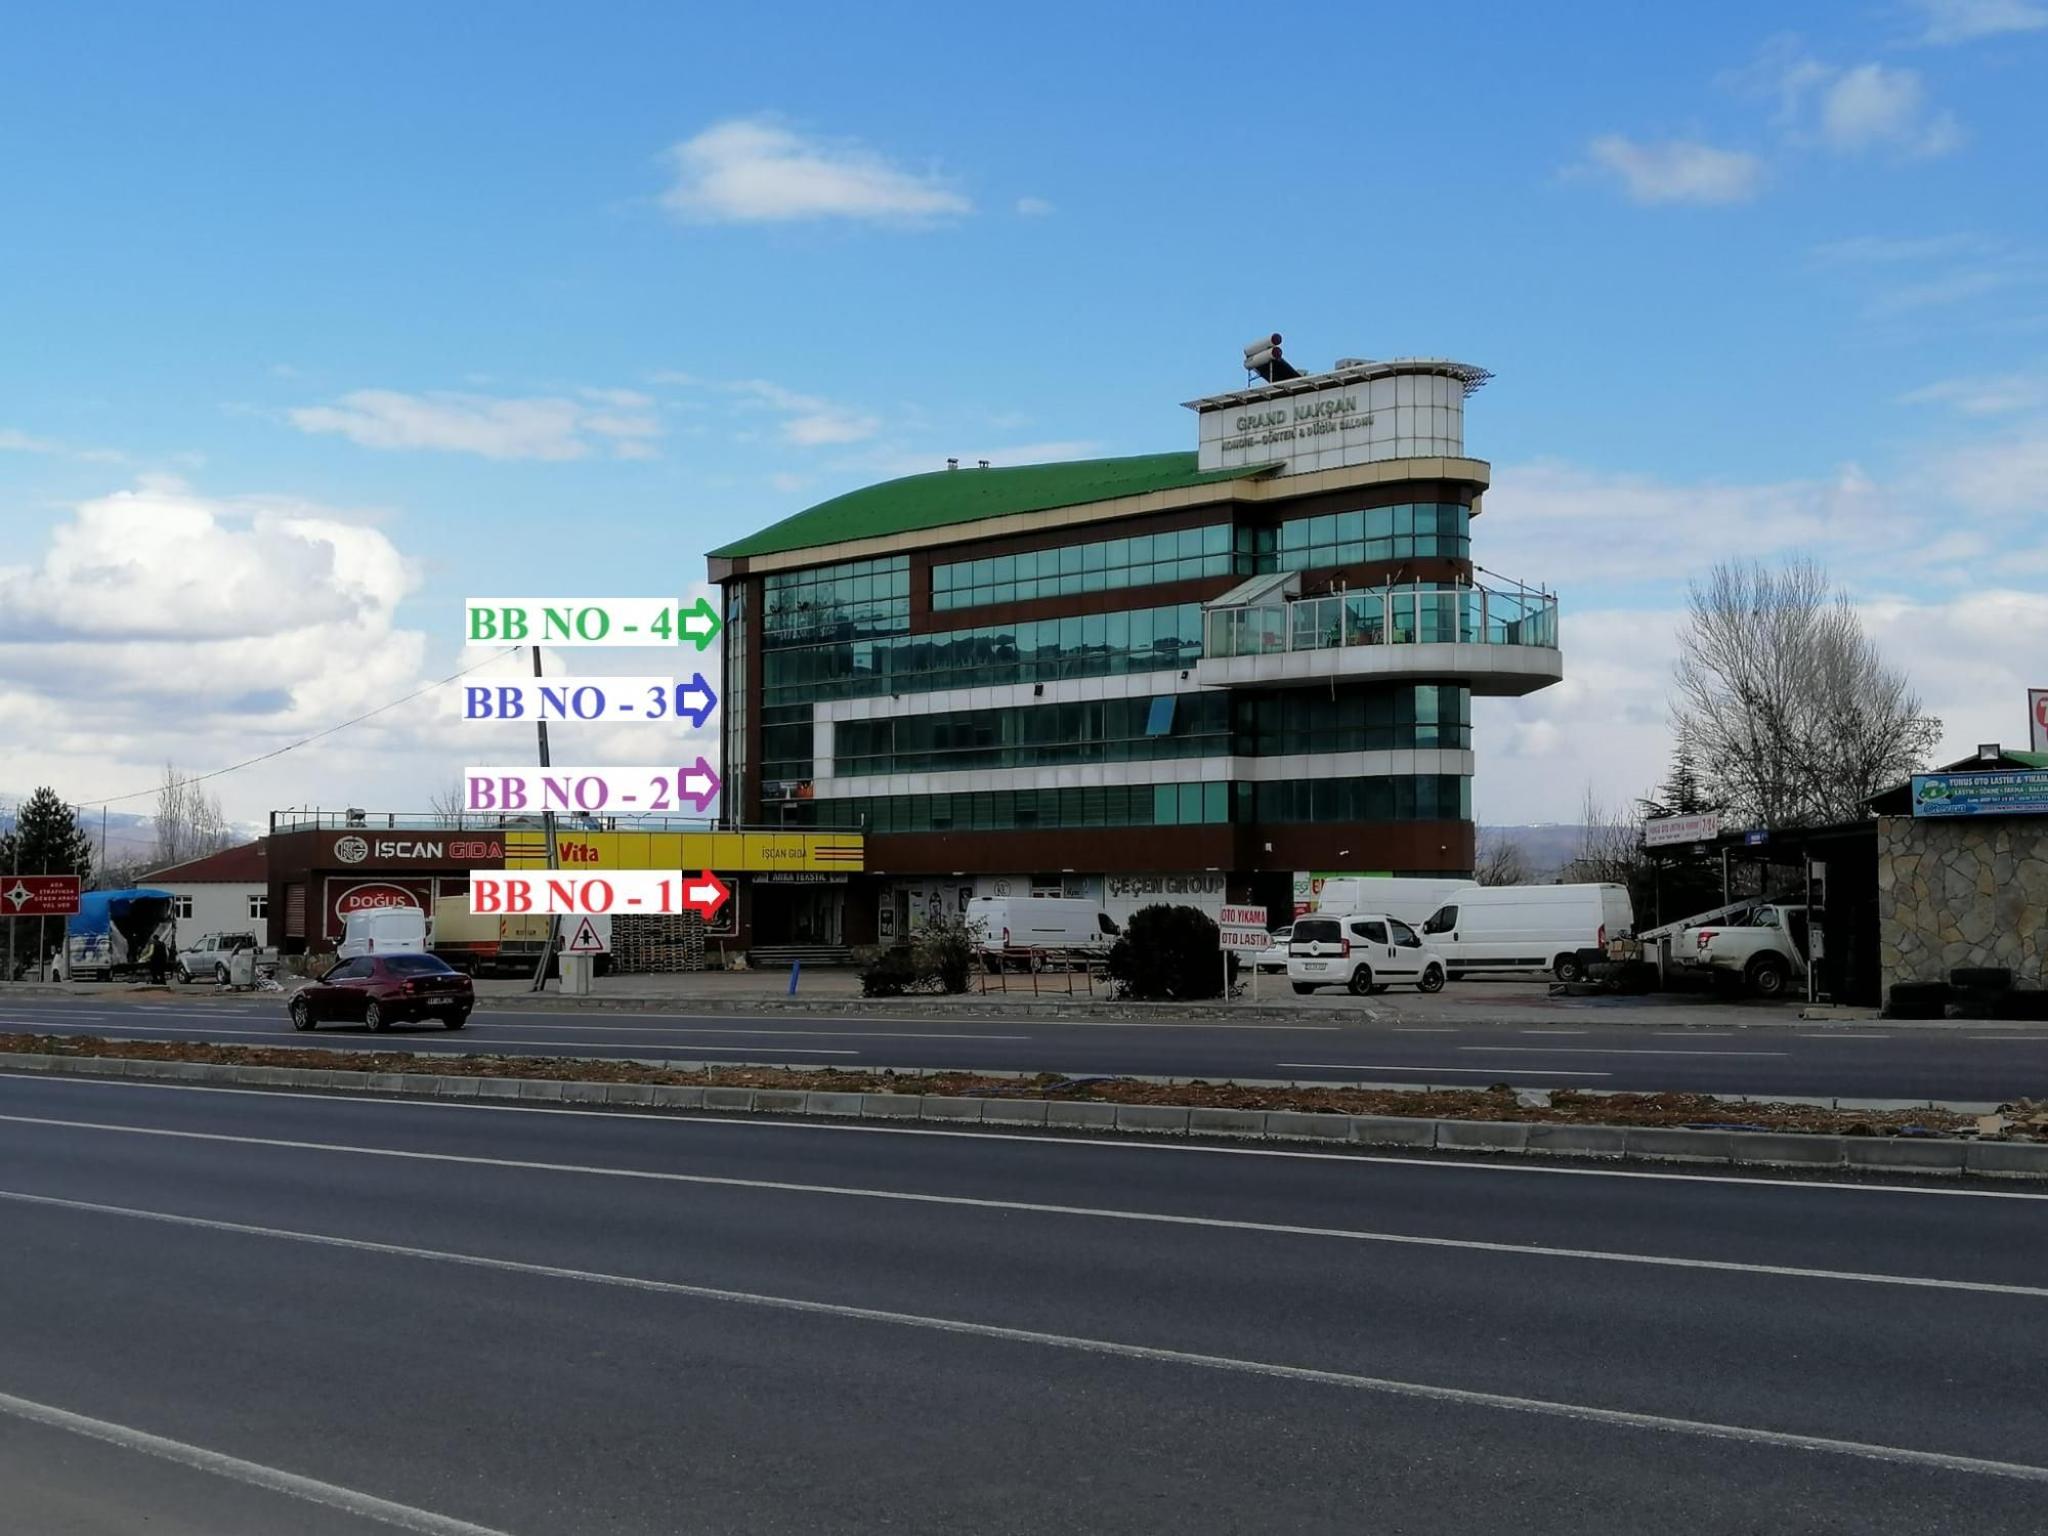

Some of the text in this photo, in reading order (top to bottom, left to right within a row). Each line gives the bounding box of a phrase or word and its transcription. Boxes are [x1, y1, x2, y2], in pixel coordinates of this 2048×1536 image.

[1236, 409, 1287, 431] GRAND
[1974, 777, 1989, 785] OTO
[375, 839, 443, 859] İŞCAN
[450, 841, 504, 859] GIDA
[559, 842, 599, 862] Vita
[1107, 876, 1163, 898] ÇEÇEN
[1164, 876, 1224, 894] GROUP
[1221, 909, 1265, 924] OTO YIKAMA
[1222, 932, 1269, 946] OTO LASTİK
